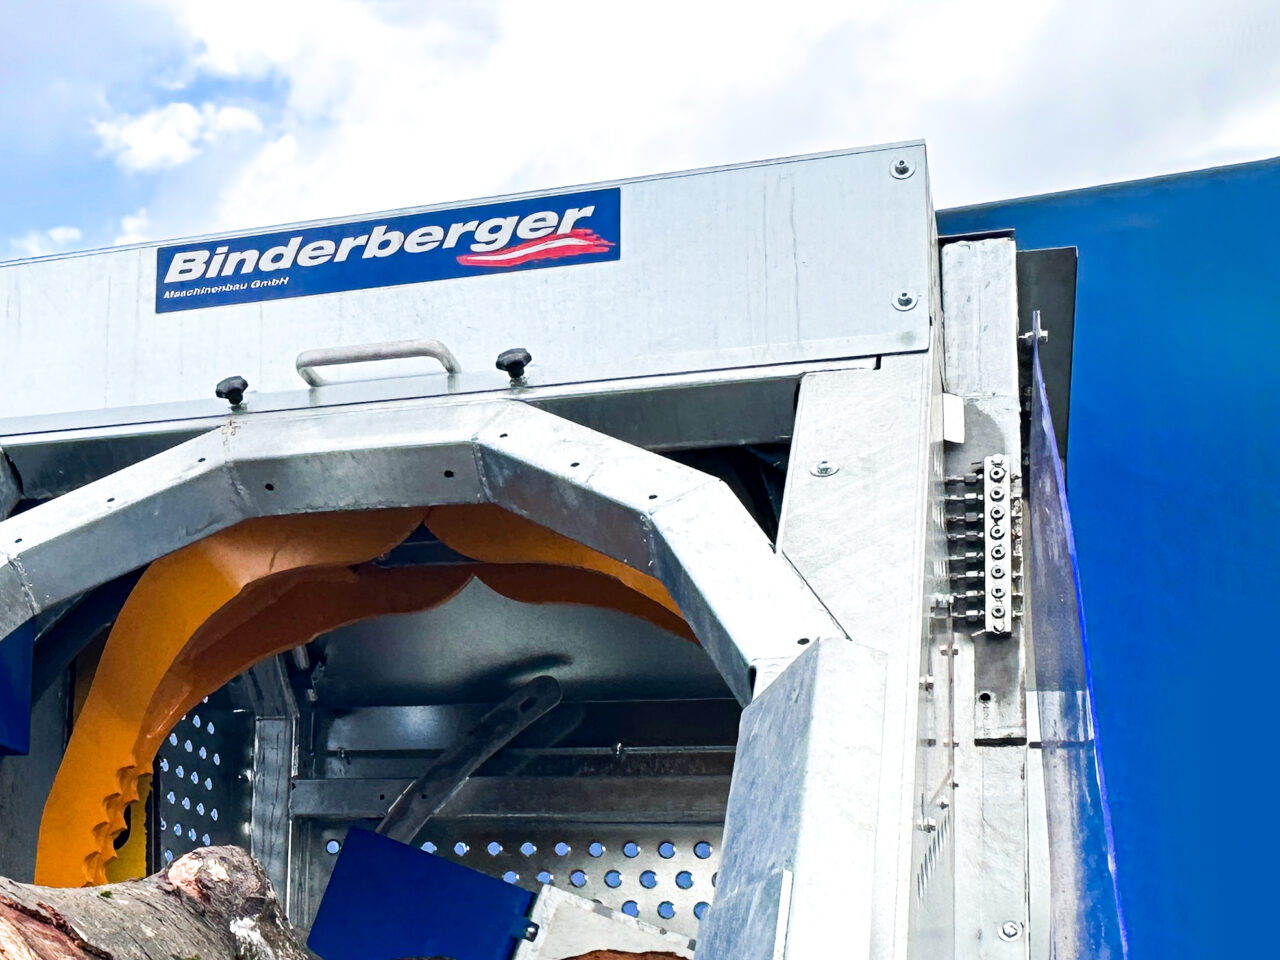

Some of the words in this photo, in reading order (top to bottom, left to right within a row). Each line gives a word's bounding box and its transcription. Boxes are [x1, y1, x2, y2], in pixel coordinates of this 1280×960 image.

[163, 205, 596, 284] Binderberger
[163, 282, 248, 299] Maschinenbau
[250, 276, 290, 289] GmbH
